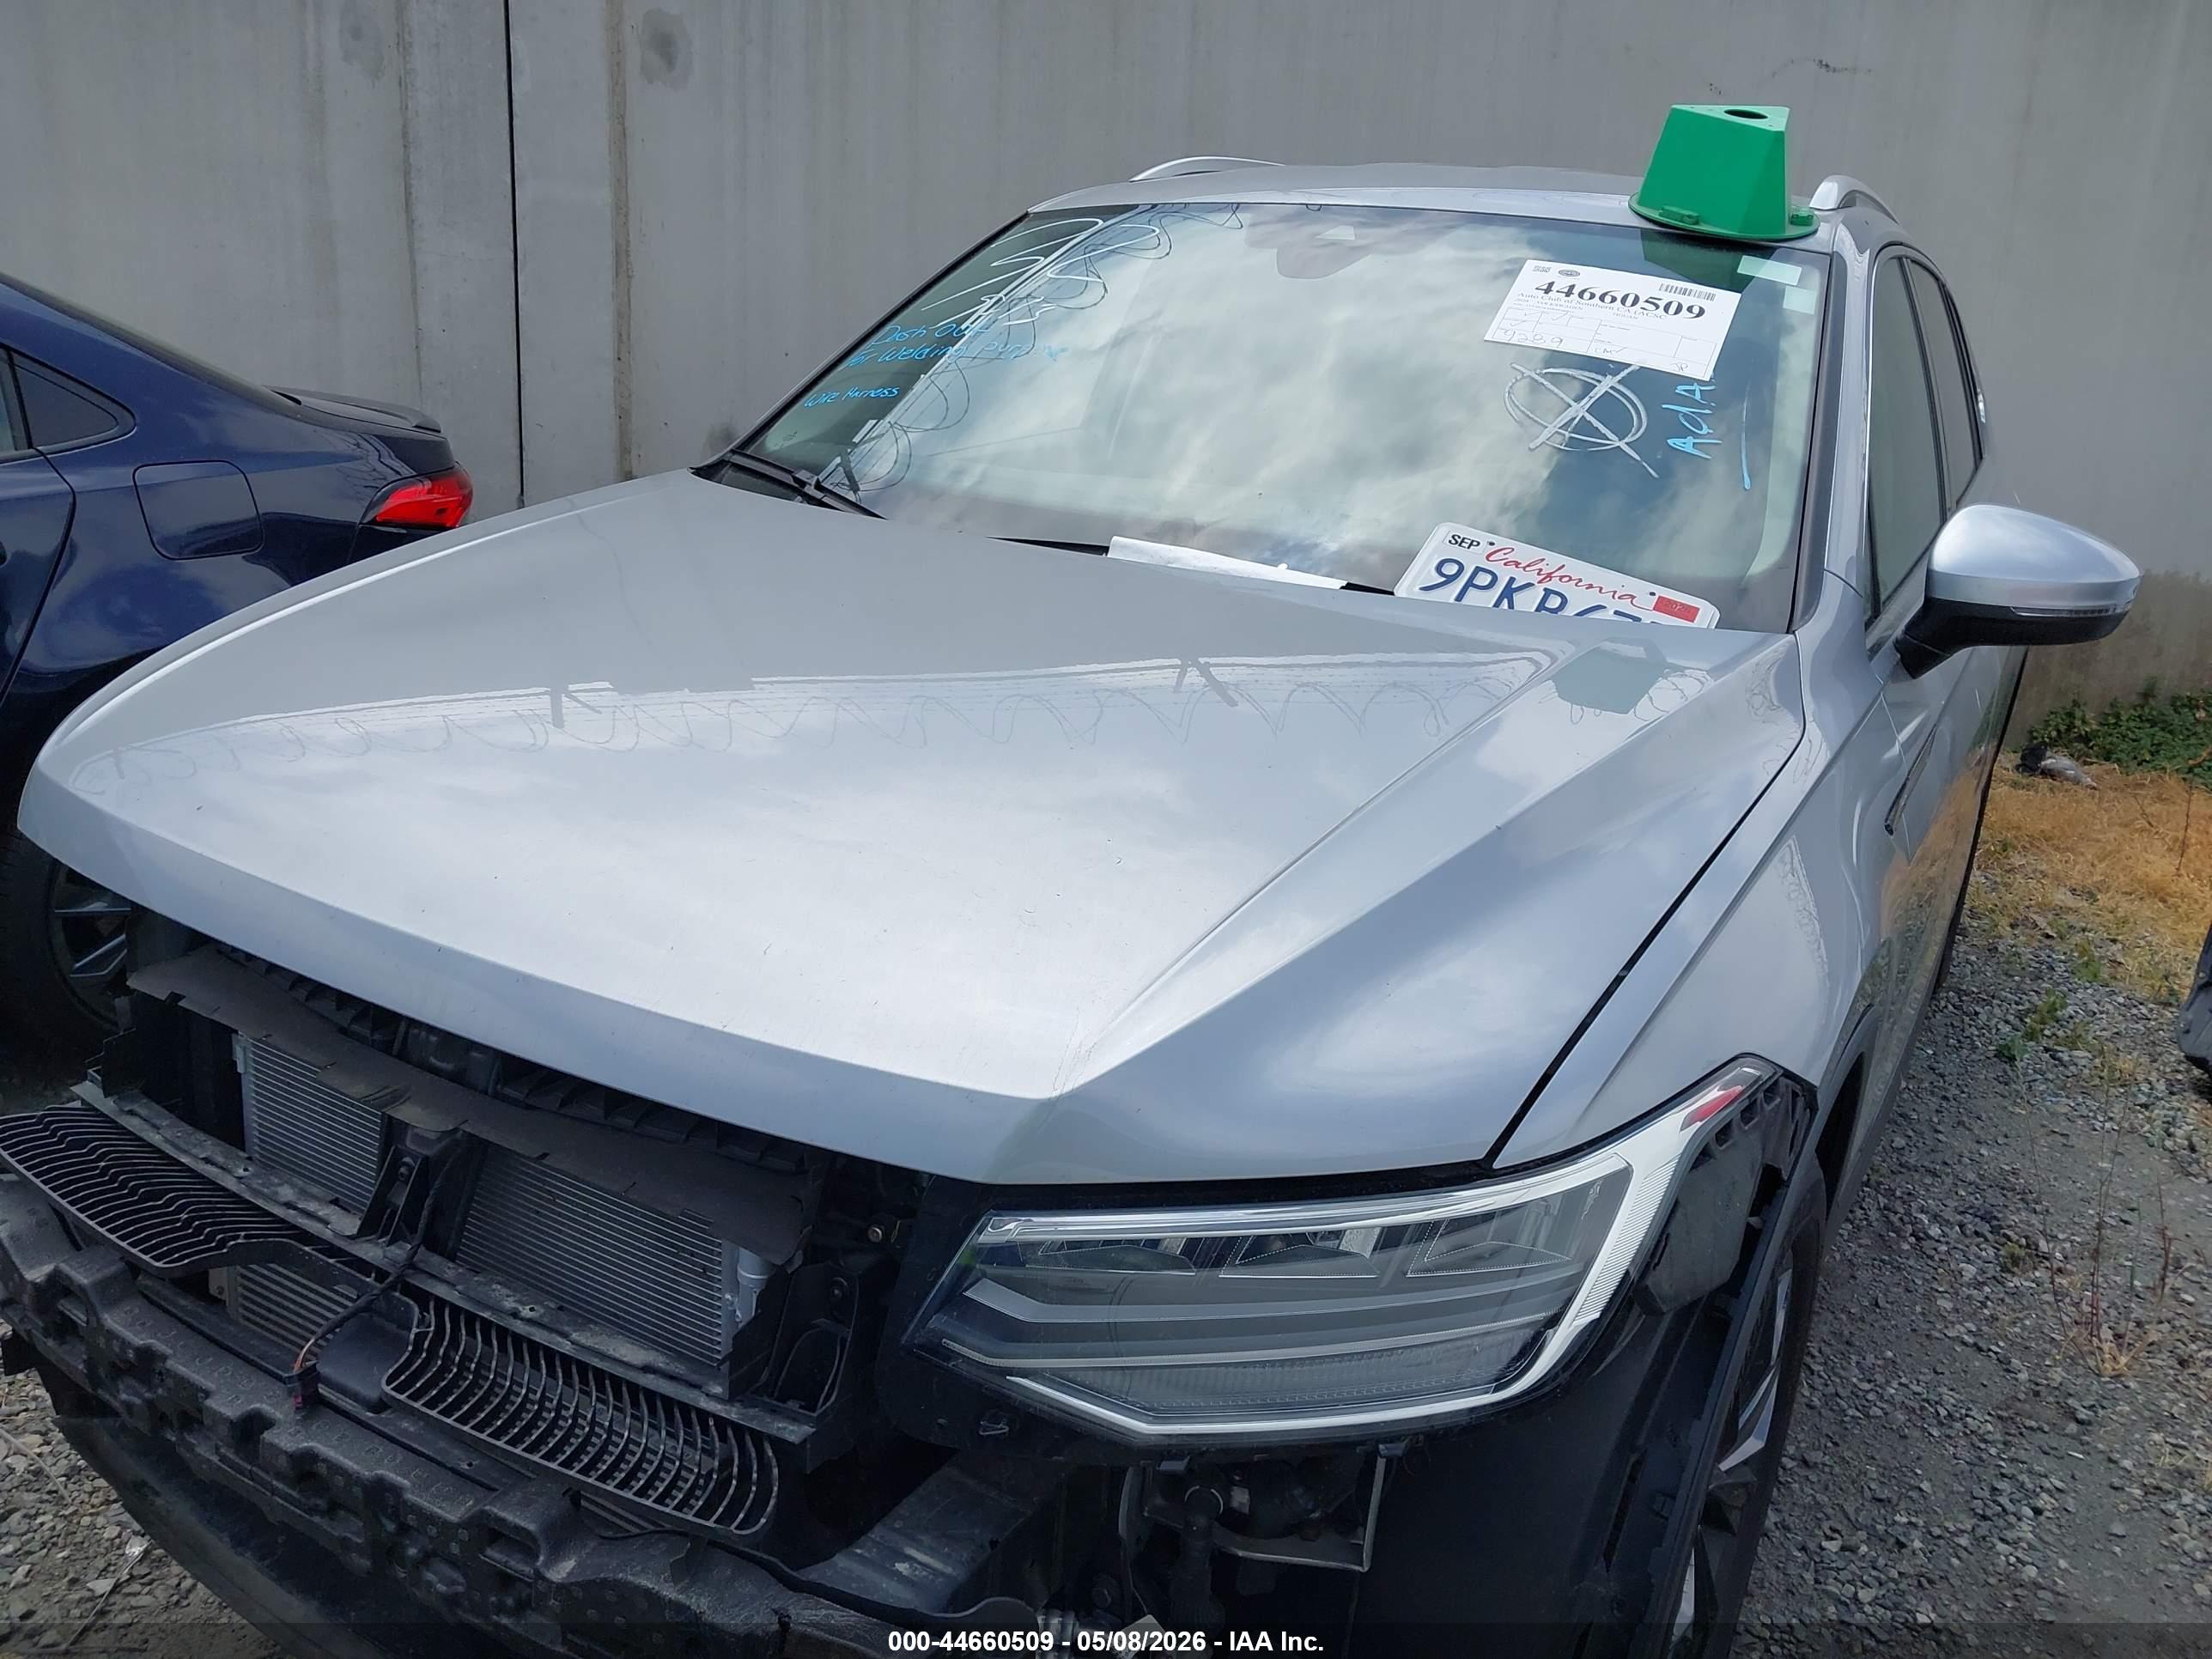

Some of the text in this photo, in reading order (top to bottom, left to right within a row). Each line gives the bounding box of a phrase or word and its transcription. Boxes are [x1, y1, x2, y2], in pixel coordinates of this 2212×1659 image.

[1534, 280, 1705, 319] 44660509
[1540, 295, 1562, 303] Club
[1575, 300, 1614, 311] Southern
[1448, 534, 1480, 550] SEP
[1486, 547, 1652, 611] California
